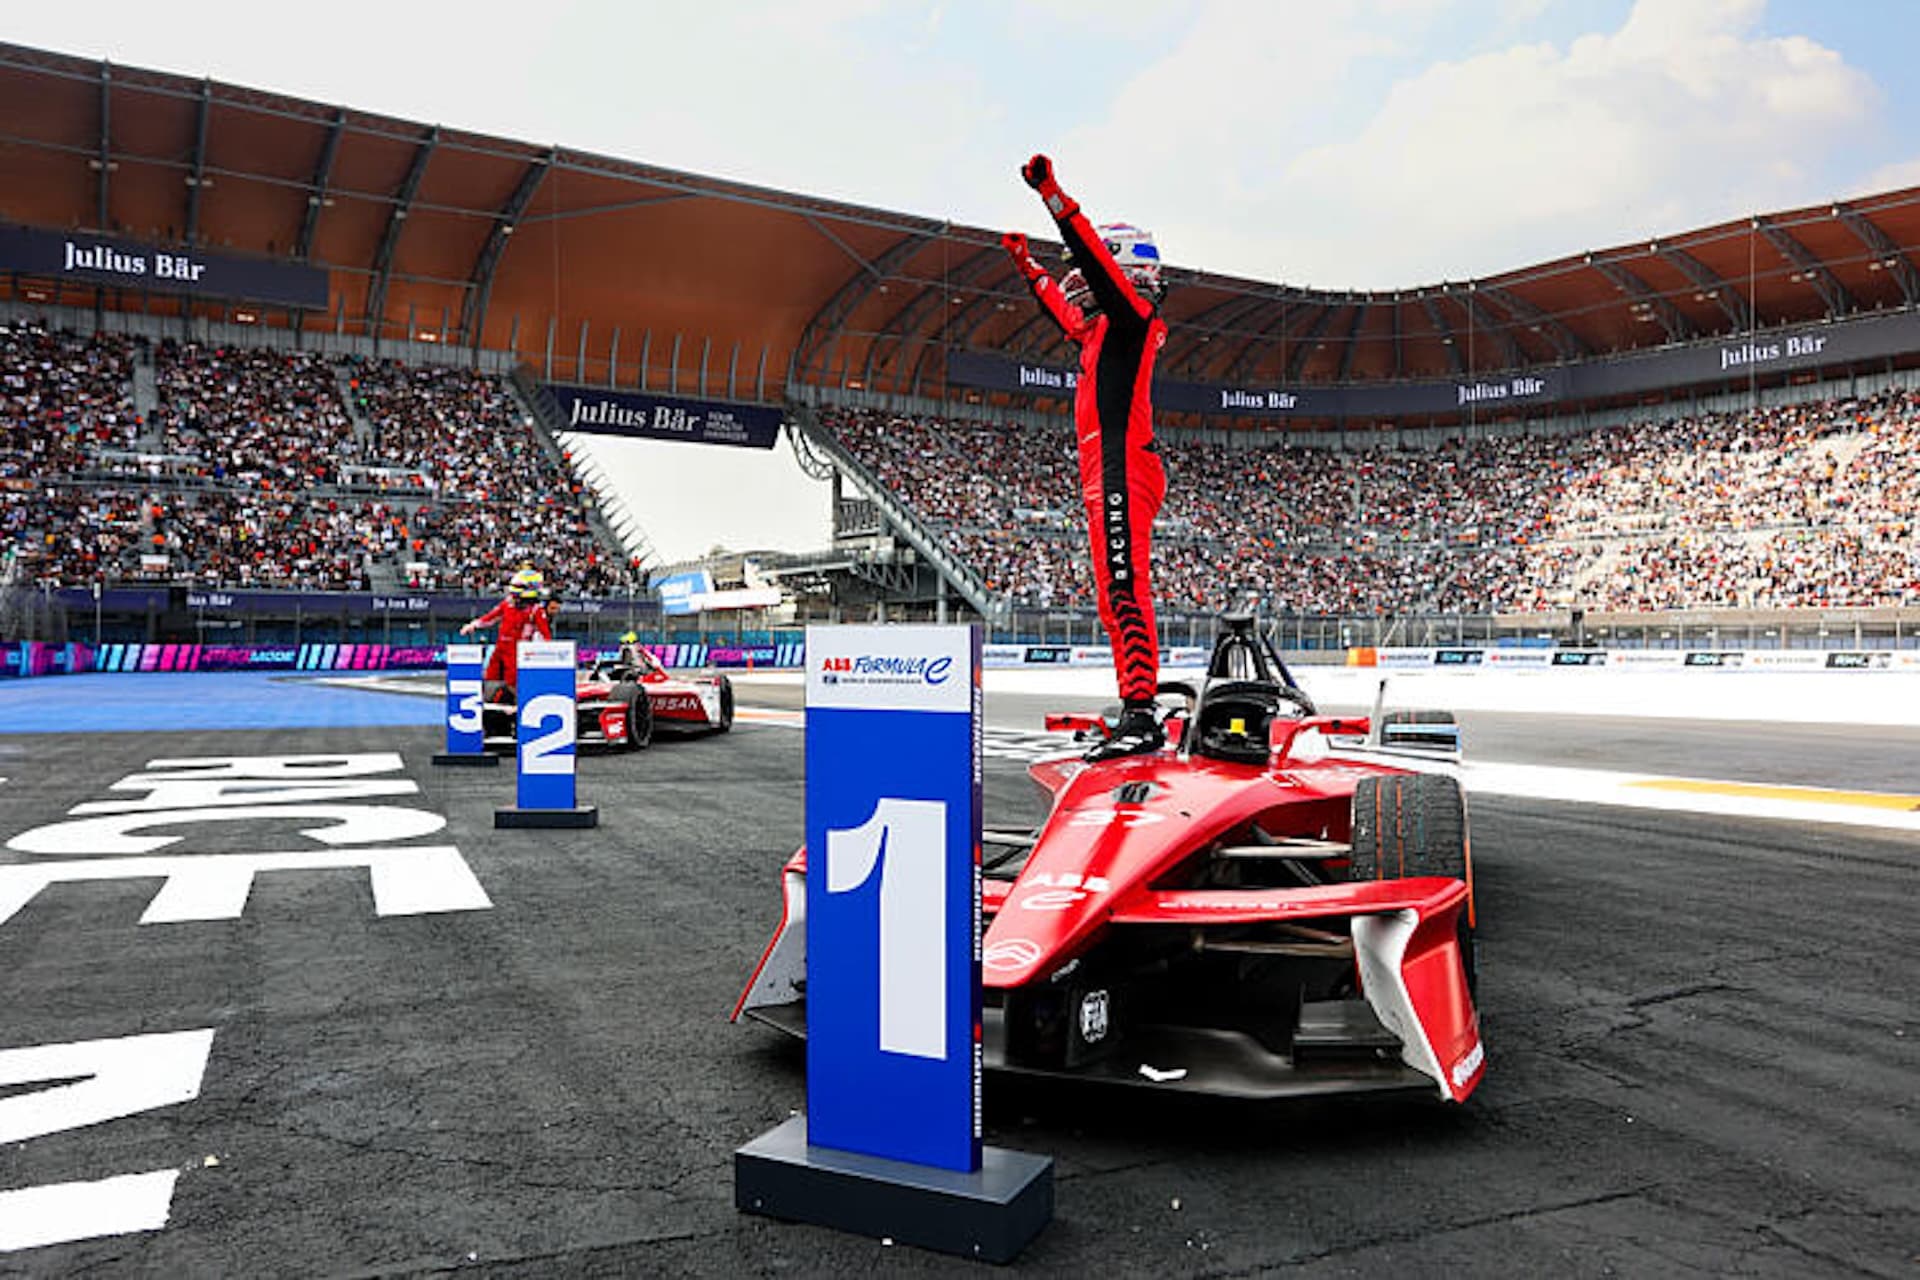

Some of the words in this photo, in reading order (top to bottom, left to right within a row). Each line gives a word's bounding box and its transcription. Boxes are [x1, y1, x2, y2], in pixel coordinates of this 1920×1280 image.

[65, 242, 147, 274] Julius
[155, 254, 205, 281] Bär
[1721, 344, 1779, 369] Julius
[1786, 335, 1827, 355] Bär
[1020, 365, 1061, 388] Julius
[1458, 383, 1508, 404] Julius
[1511, 377, 1545, 396] Bär
[570, 398, 647, 427] Julius
[652, 405, 701, 431] Bär
[1223, 390, 1264, 408] Julius
[1268, 391, 1297, 409] Bär
[1107, 492, 1128, 580] RACING
[822, 658, 851, 671] ABB
[449, 680, 482, 733] 3
[649, 697, 698, 710] ISSAN
[520, 695, 575, 774] 2
[0, 753, 494, 927] RACE
[826, 797, 947, 1059] 1
